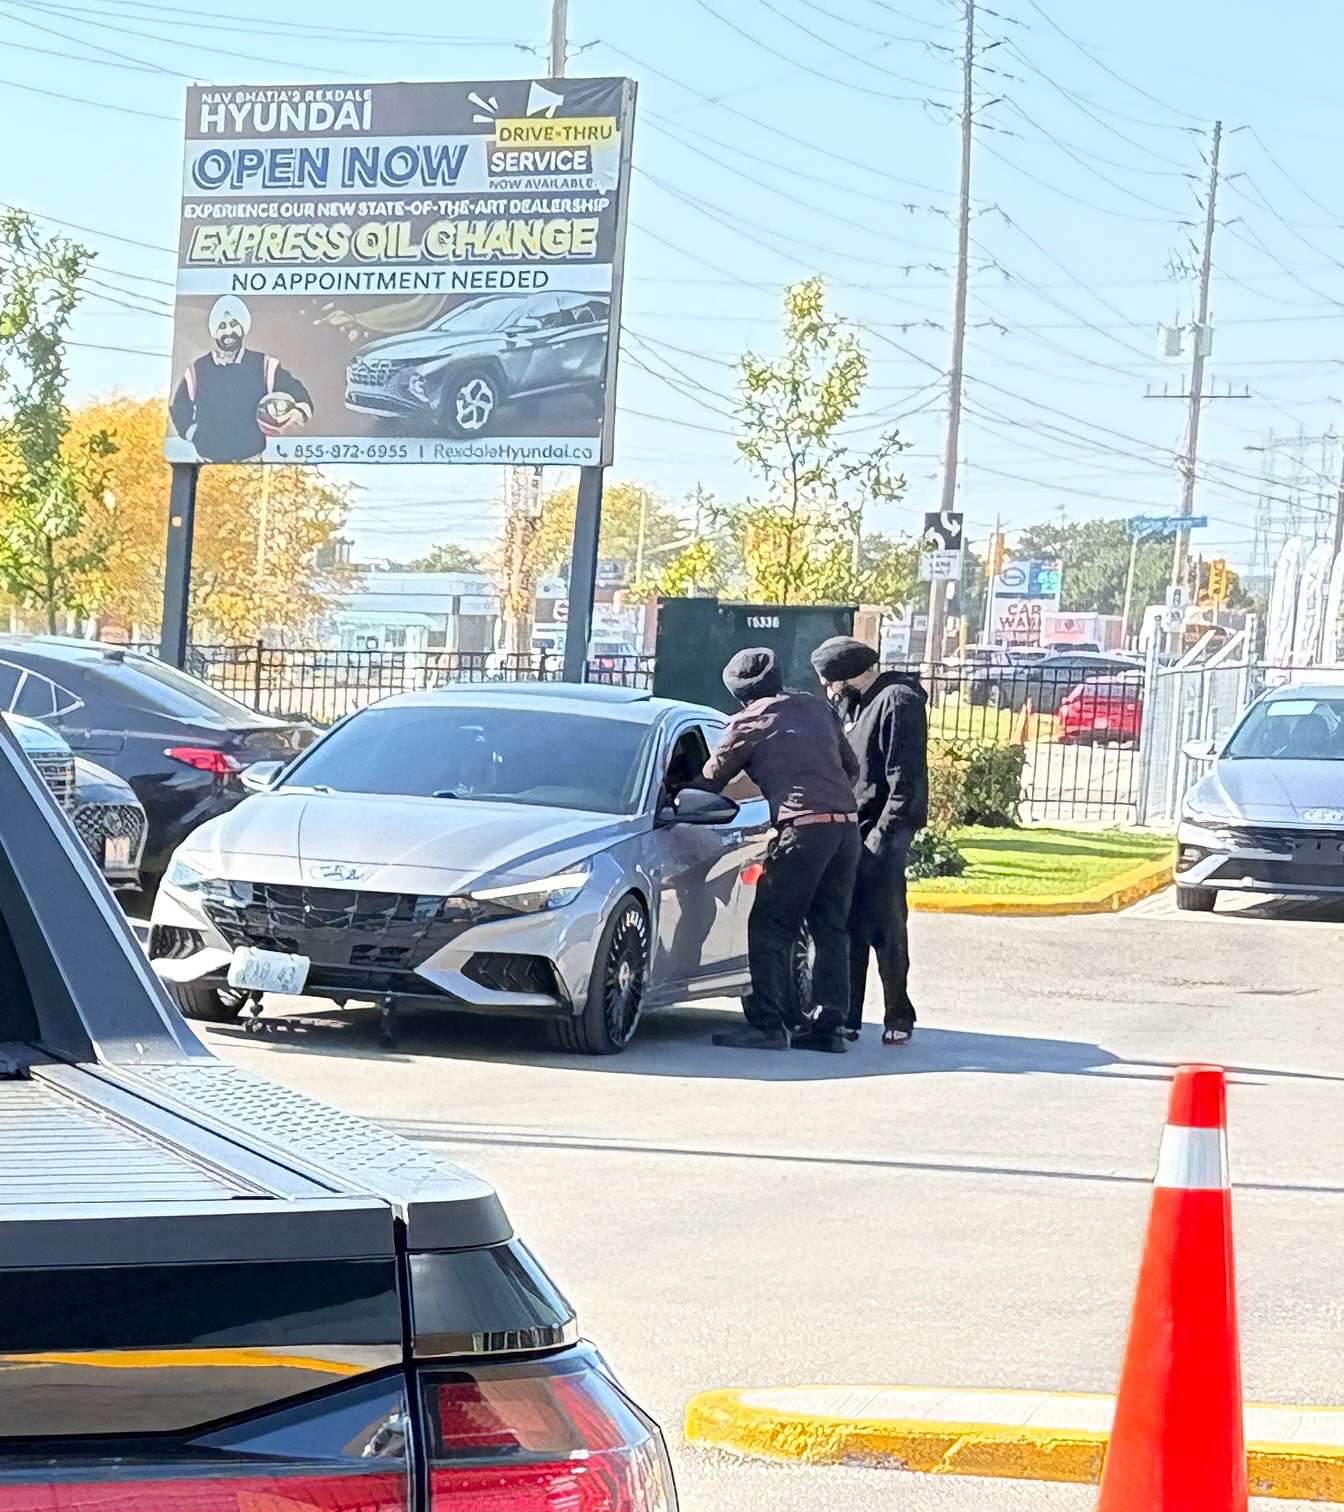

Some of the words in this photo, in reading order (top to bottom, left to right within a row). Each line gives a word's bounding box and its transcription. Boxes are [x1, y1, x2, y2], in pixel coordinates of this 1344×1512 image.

[200, 101, 373, 133] HYUNDAI
[192, 147, 330, 190] OPEN
[340, 144, 469, 188] NOW
[490, 150, 589, 173] SERVICE
[184, 203, 279, 218] EXPERIENCE
[280, 202, 316, 217] OUR
[317, 201, 356, 217] NEW
[510, 197, 610, 214] DEALERSHIP
[186, 223, 353, 265] EXPRESS
[350, 220, 421, 263] OIL
[421, 217, 600, 262] CHANGE
[231, 272, 267, 291] NO
[271, 271, 447, 291] APPOINTMENT
[451, 270, 550, 289] NEEDED
